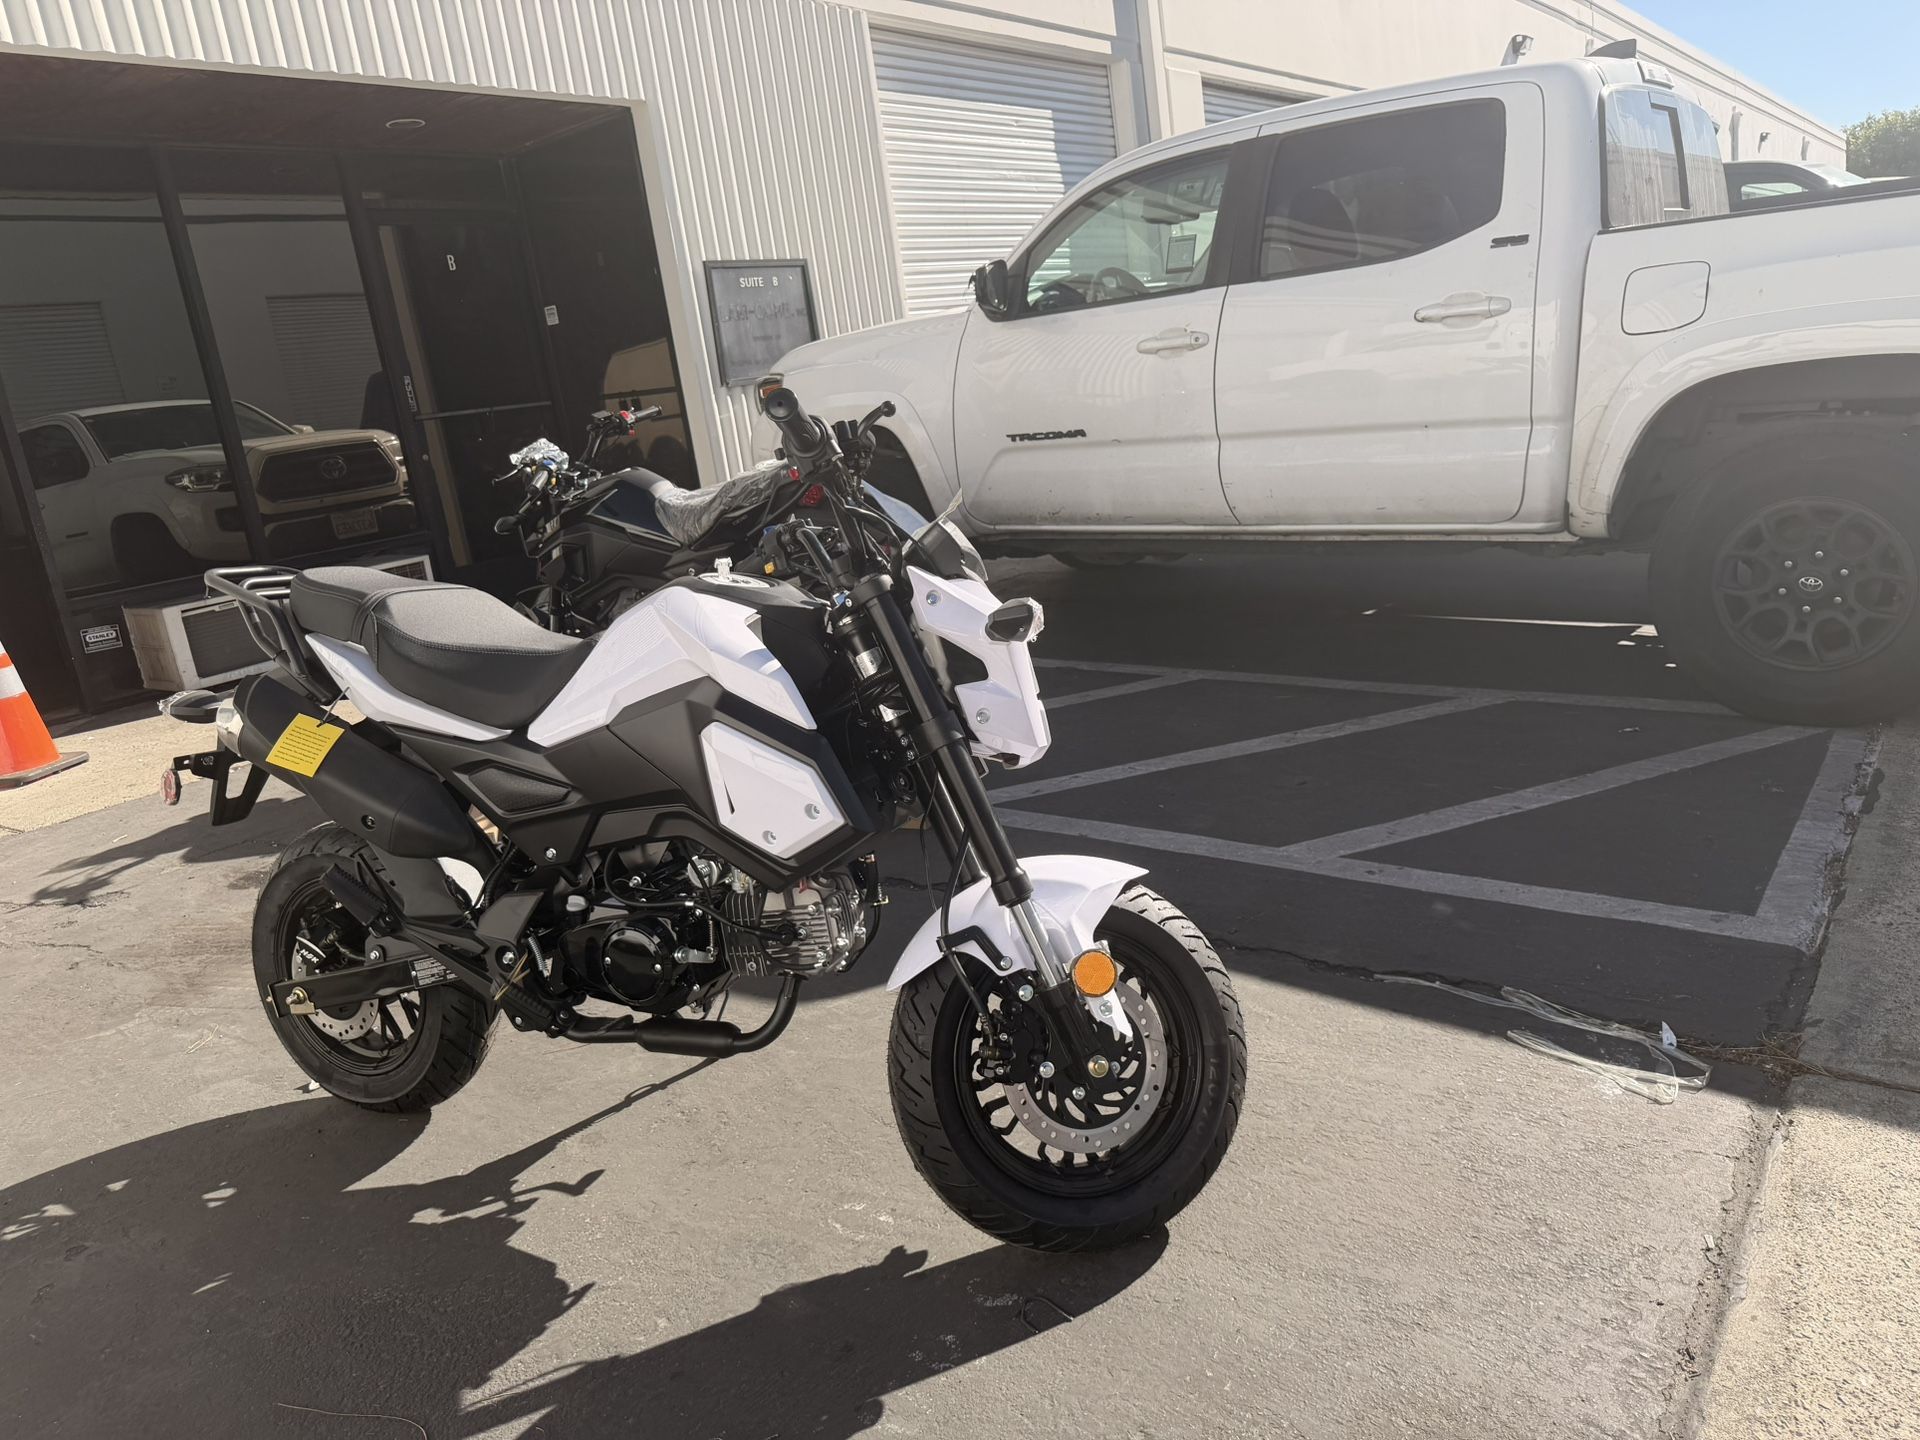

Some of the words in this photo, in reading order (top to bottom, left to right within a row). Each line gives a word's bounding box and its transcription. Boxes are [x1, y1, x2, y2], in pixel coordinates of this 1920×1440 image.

[447, 255, 456, 270] B
[739, 277, 765, 288] SUITE
[772, 276, 779, 287] B
[1006, 429, 1087, 442] TACOMA
[87, 631, 115, 642] STANLEY
